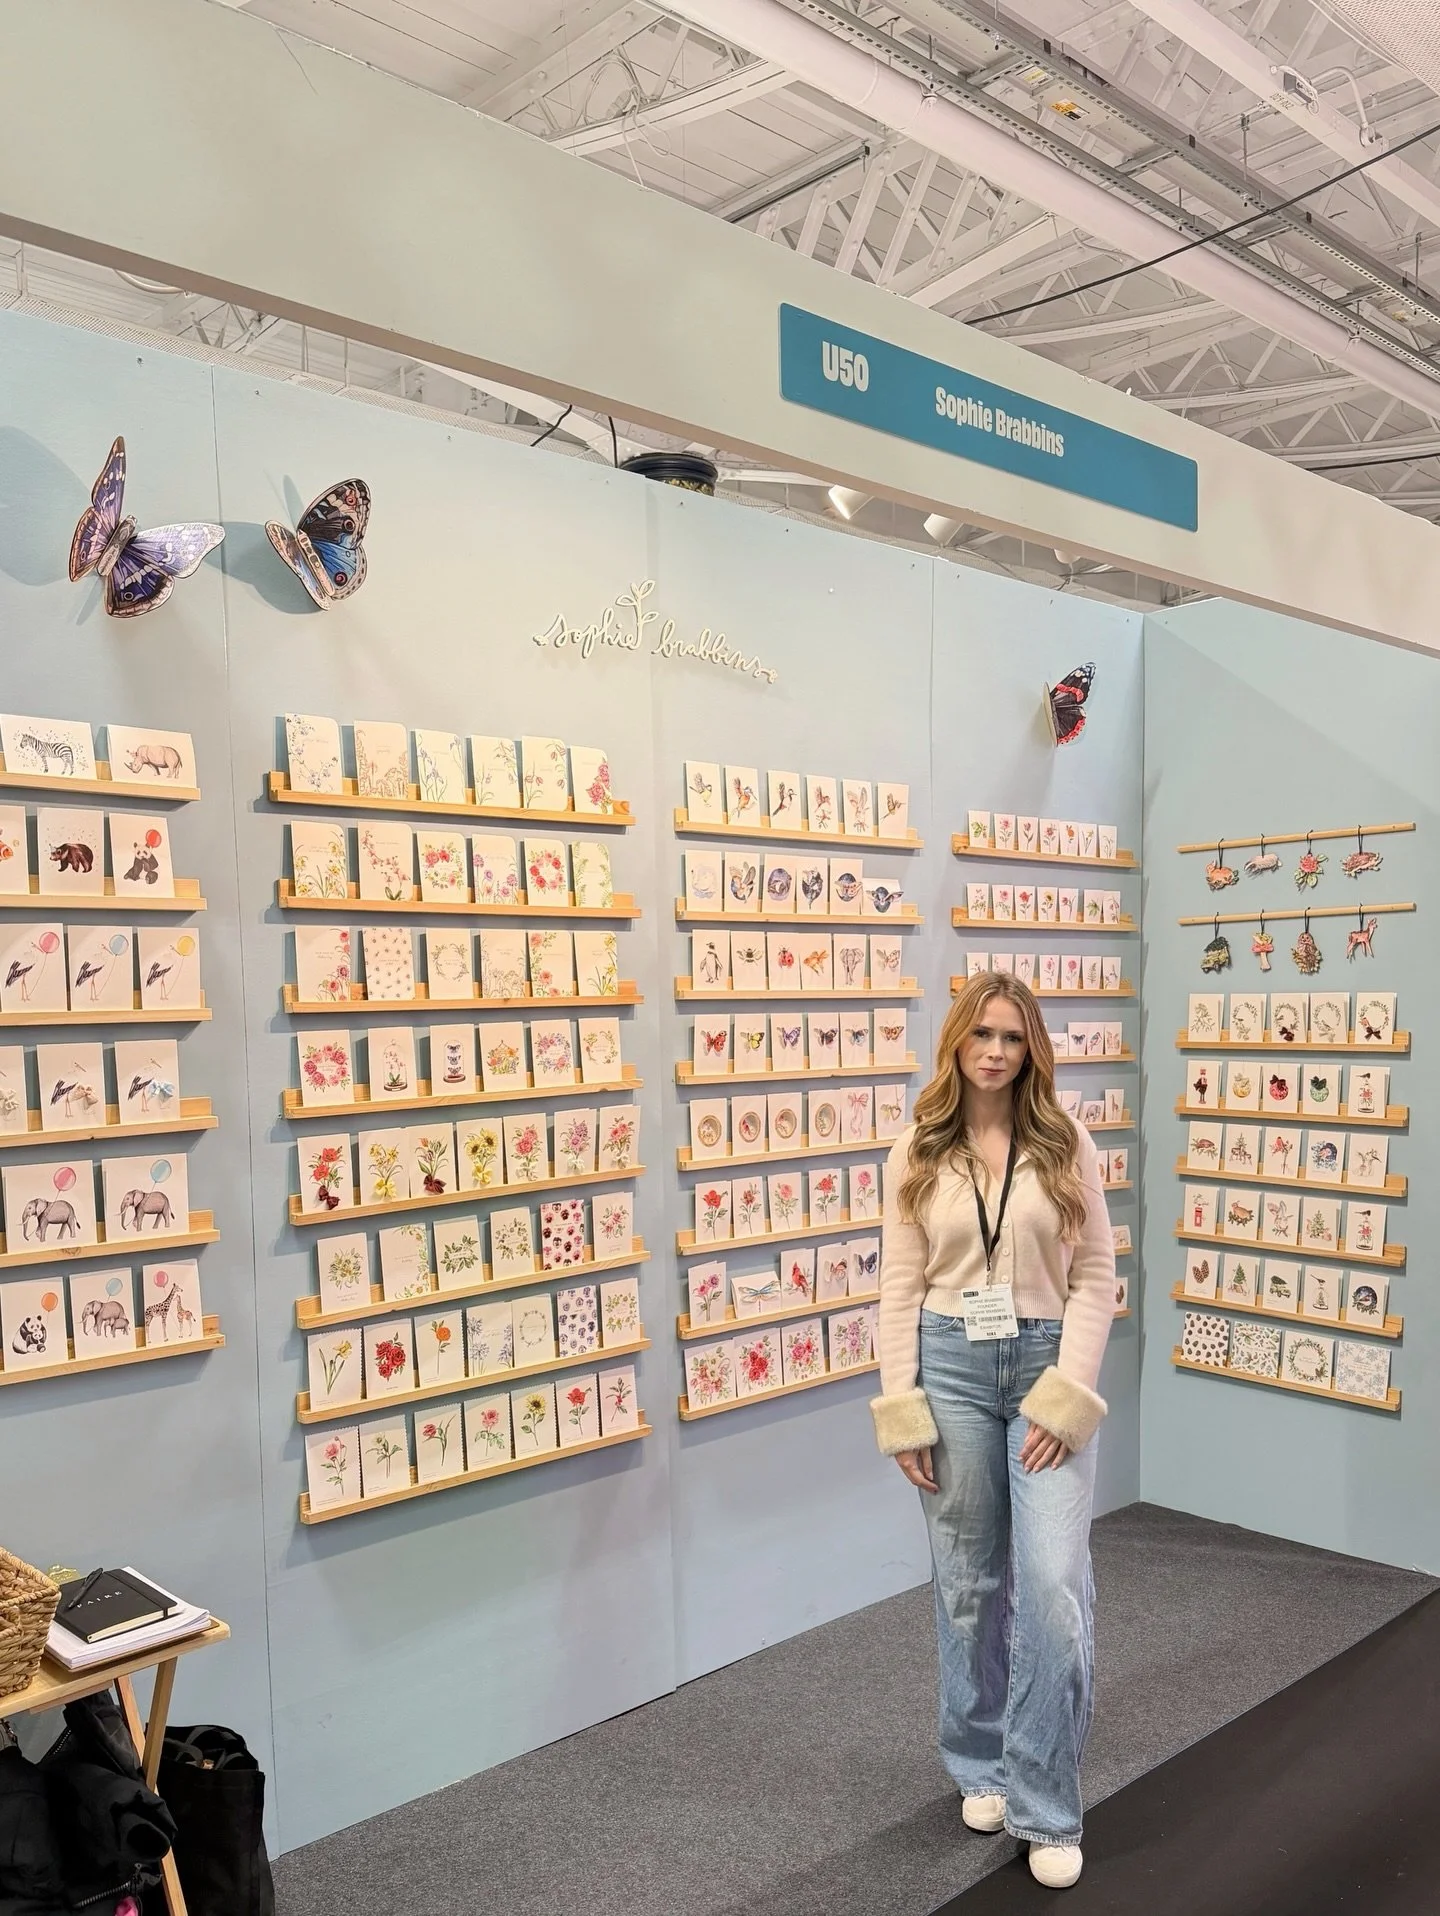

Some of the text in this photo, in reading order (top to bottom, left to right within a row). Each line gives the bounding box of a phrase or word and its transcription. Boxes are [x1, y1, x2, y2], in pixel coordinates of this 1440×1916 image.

[822, 341, 869, 392] U50
[935, 386, 1064, 457] Sophie Brabbins
